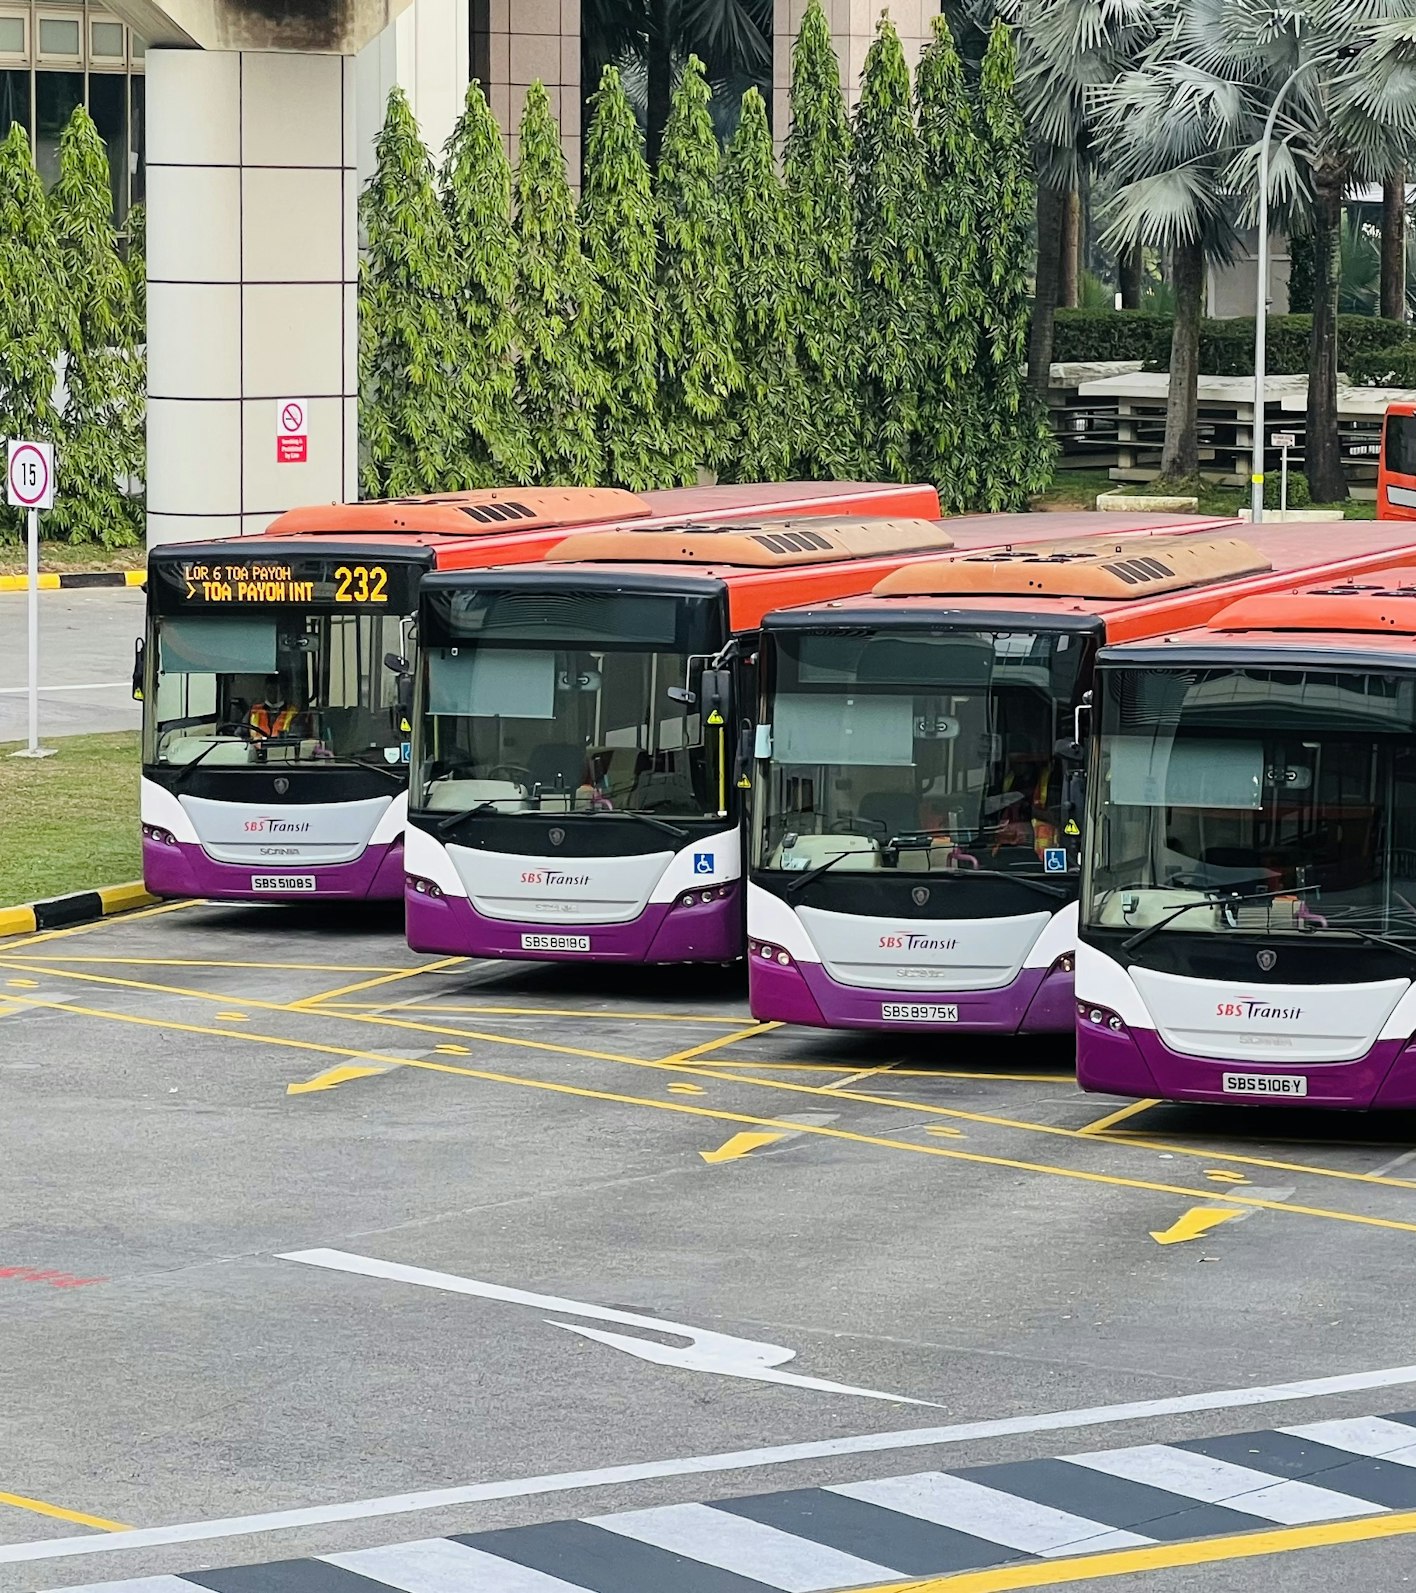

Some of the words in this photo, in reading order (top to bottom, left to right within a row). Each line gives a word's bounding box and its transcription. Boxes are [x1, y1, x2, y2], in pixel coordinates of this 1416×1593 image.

[21, 462, 37, 487] 15
[185, 566, 209, 580] LOR
[212, 566, 222, 580] 6
[225, 566, 249, 580] TOA
[252, 566, 291, 580] PAYOH
[202, 582, 232, 601] TOA
[238, 582, 285, 601] PAYOH
[289, 582, 314, 601] INT
[334, 566, 388, 602] 232
[244, 821, 265, 832] SBS
[264, 819, 312, 833] Transit
[520, 872, 542, 884] SBS
[541, 871, 592, 886] Transit
[879, 936, 903, 949] SBS
[902, 934, 961, 950] Transit
[1216, 1003, 1243, 1017] SBS
[1241, 1001, 1307, 1020] Transit
